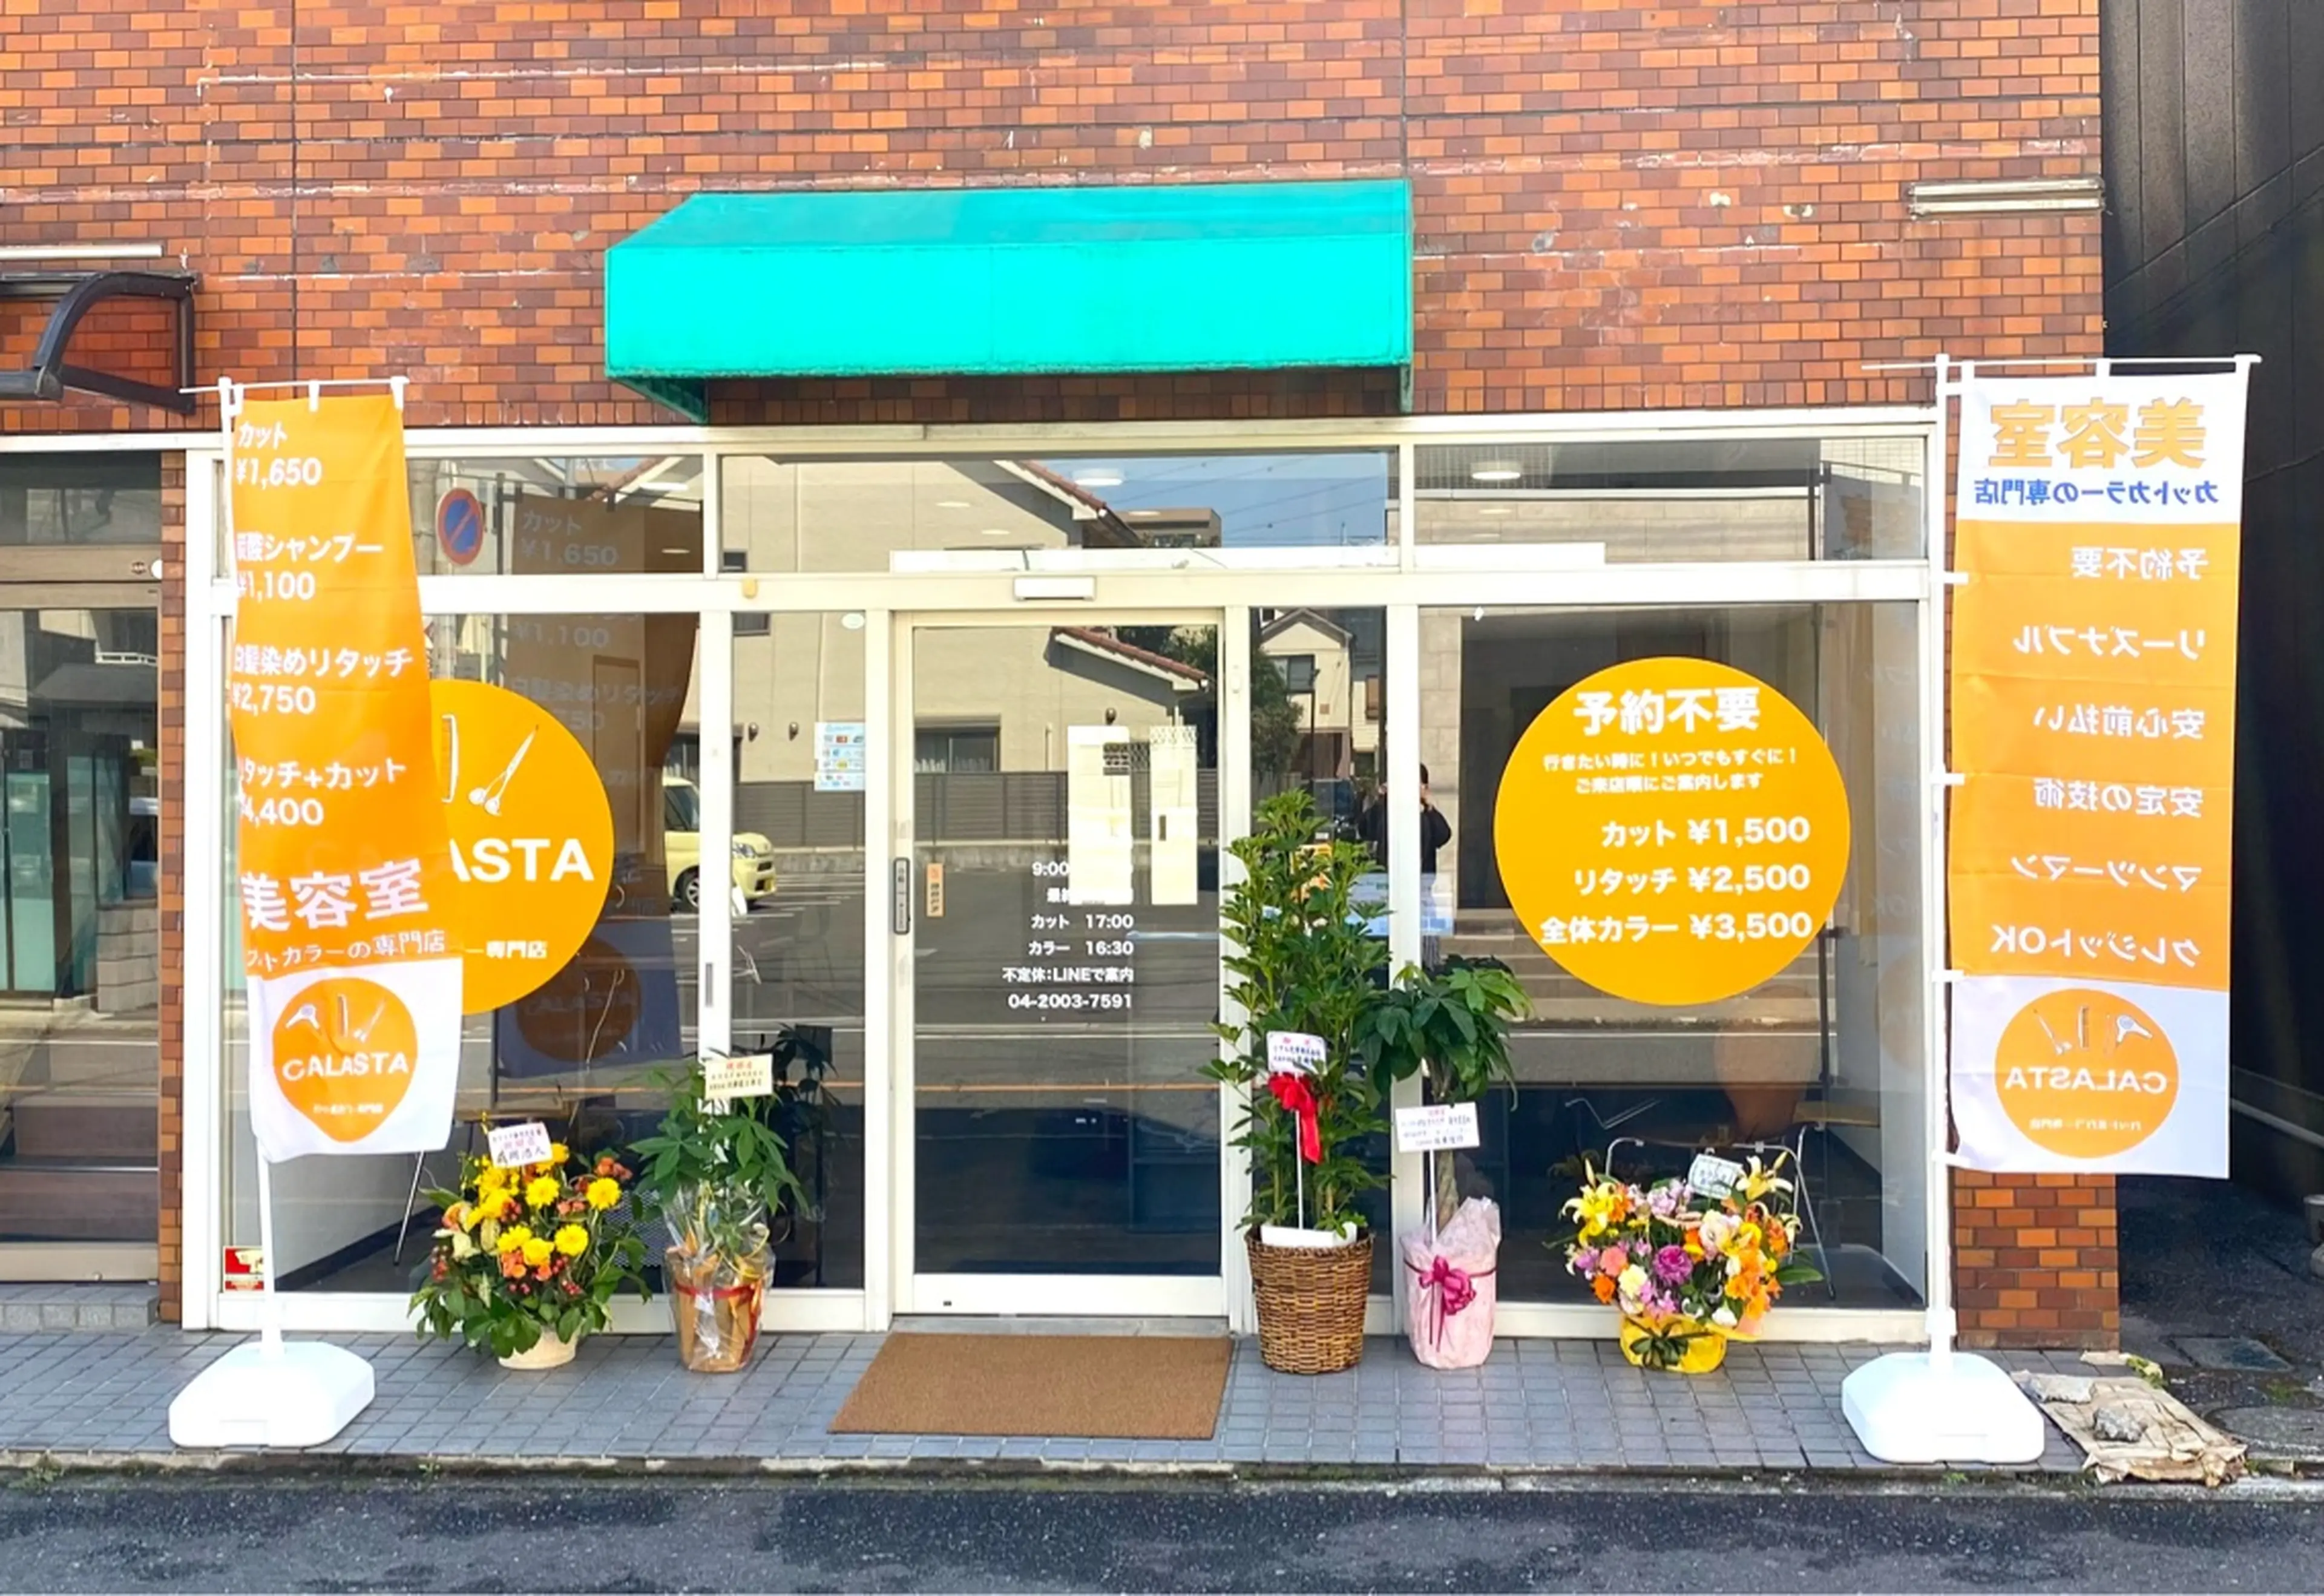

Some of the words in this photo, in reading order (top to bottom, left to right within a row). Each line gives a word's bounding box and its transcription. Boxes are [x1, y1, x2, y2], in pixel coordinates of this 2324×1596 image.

[238, 421, 288, 449] カット
[237, 458, 322, 491] ¥1,650
[1574, 686, 1761, 735] 予約不要
[1601, 820, 1676, 847] カット
[1687, 817, 1810, 847] ¥1,500
[240, 857, 428, 931] 美容室
[1574, 868, 1676, 896] リタッチ
[1687, 865, 1810, 895] ¥2,500
[1031, 914, 1070, 929] カット
[1085, 914, 1134, 928] 17:00
[1540, 916, 1678, 944] 全体カラー
[1689, 913, 1812, 943] ¥3,500
[1029, 941, 1071, 956] カラー
[1085, 941, 1134, 955] 16:30
[1008, 993, 1131, 1009] 04-2003-7591
[282, 1053, 409, 1082] CALASTA
